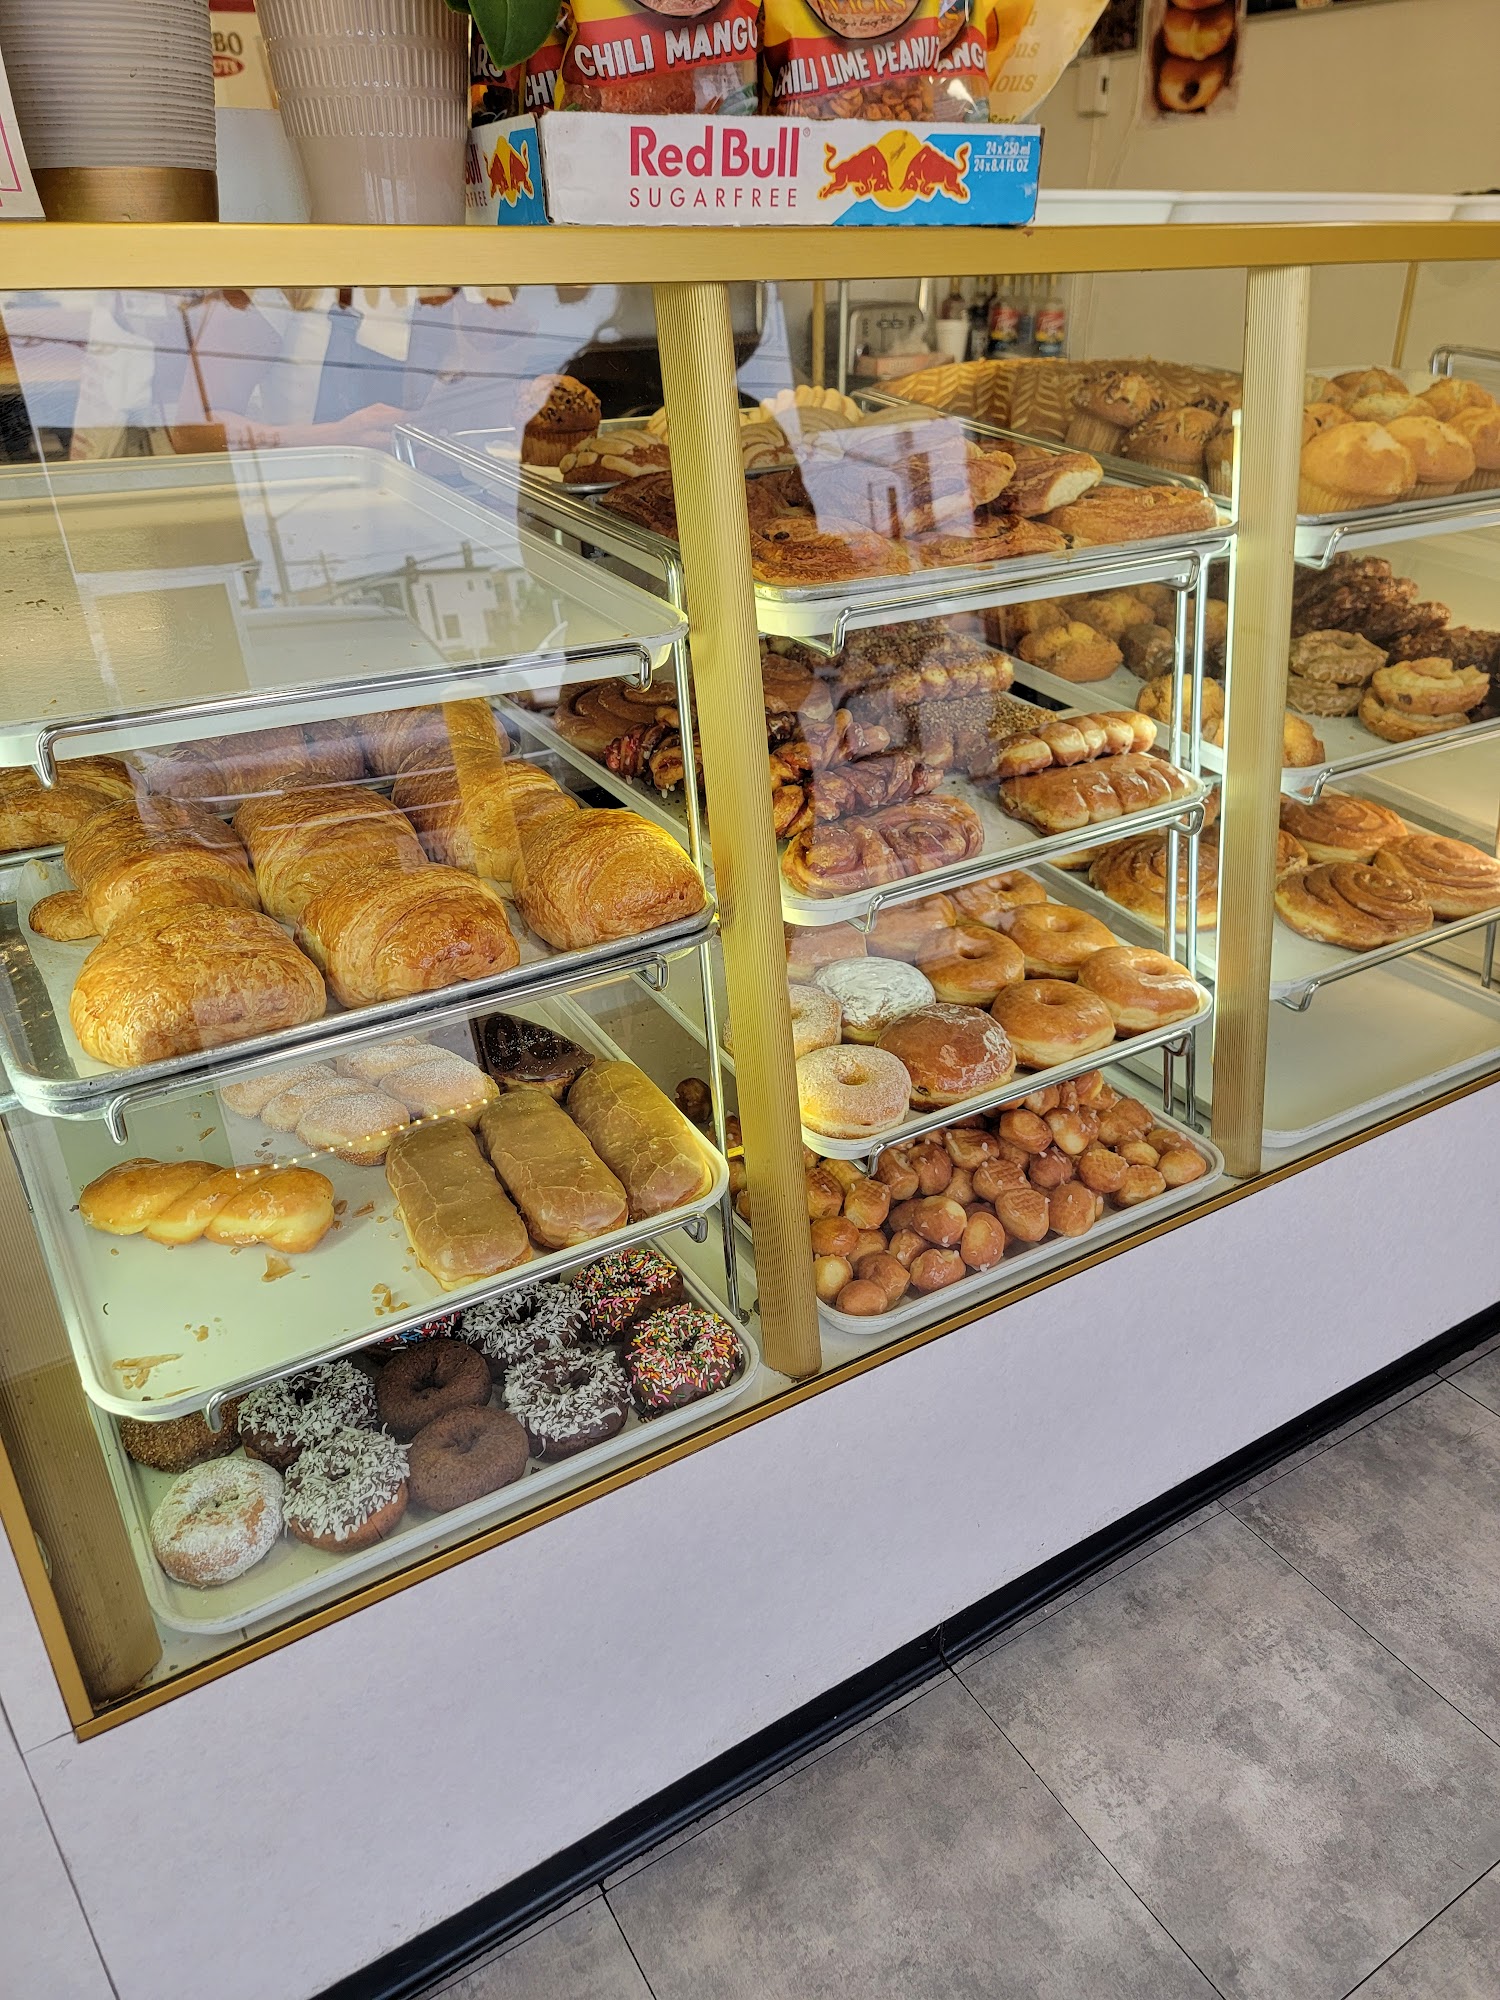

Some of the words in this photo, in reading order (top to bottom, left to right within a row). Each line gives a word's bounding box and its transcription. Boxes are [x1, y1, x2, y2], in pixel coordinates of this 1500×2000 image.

[574, 34, 655, 77] CHILI
[774, 57, 819, 98] CHILI
[821, 47, 870, 88] LIME
[630, 125, 714, 177] Red
[721, 126, 800, 178] Bull
[1006, 158, 1016, 173] FL
[1016, 158, 1029, 173] OZ
[629, 187, 798, 208] SUGARFREE
